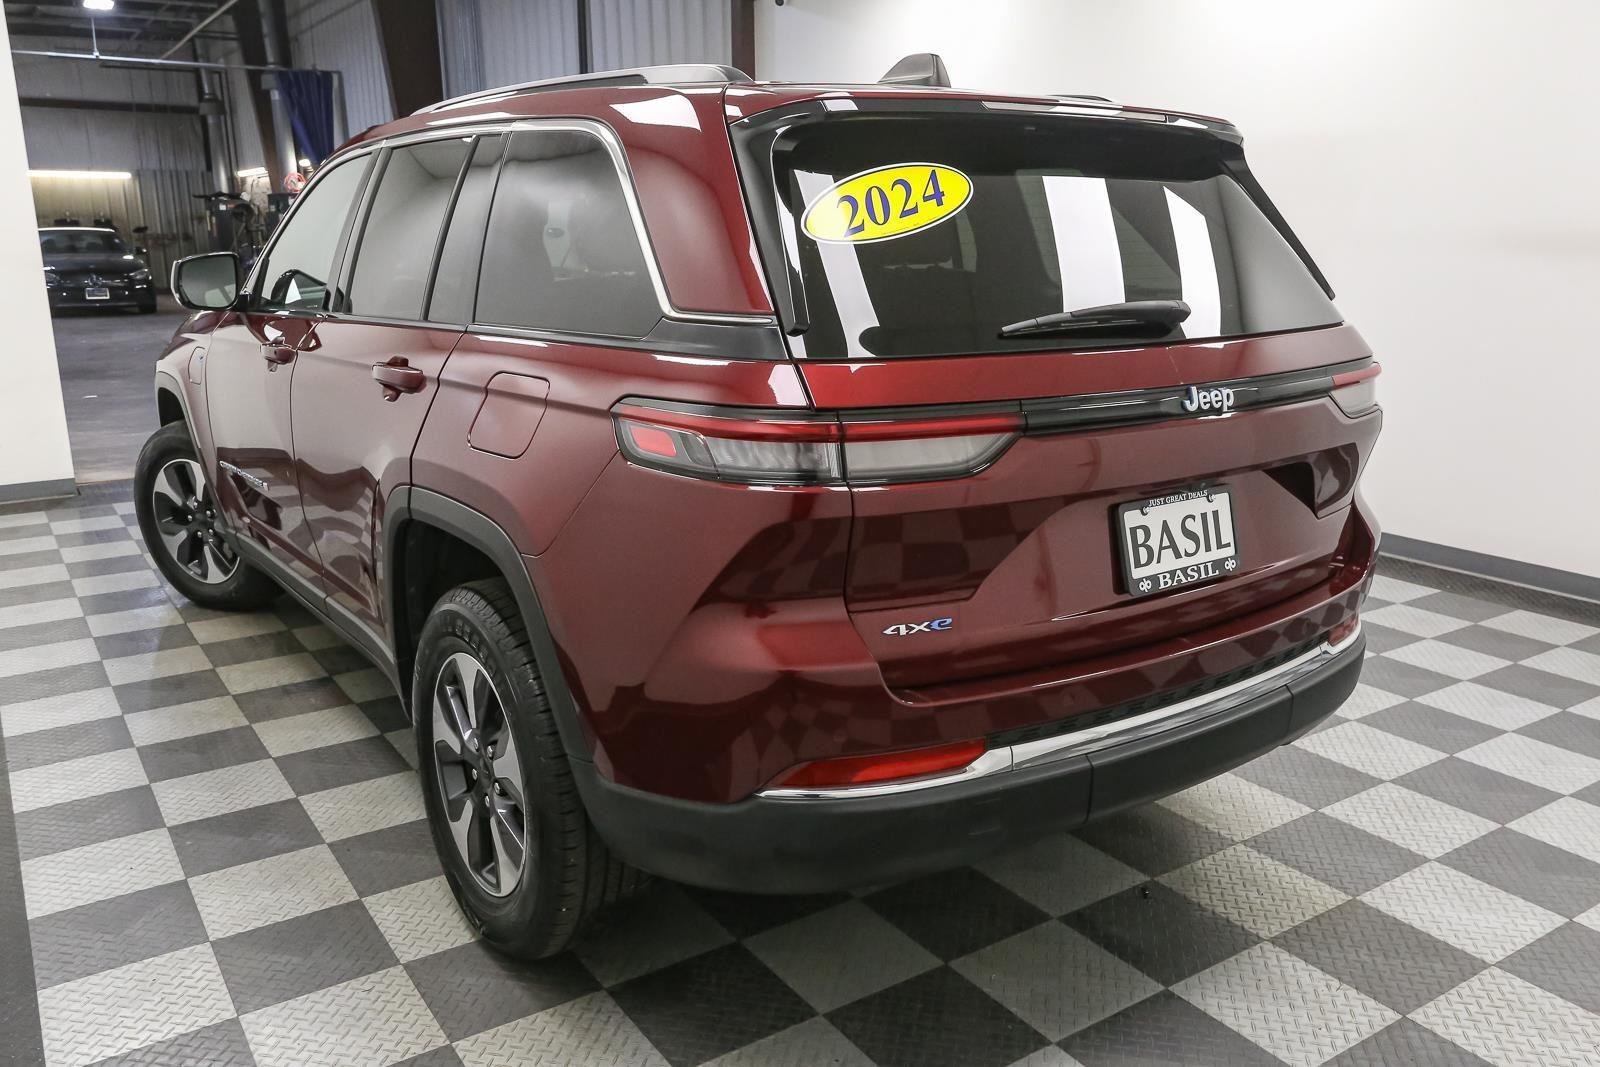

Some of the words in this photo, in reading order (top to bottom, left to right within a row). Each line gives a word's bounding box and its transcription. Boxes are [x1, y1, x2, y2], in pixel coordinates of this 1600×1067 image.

[837, 169, 945, 238] 2024
[1184, 386, 1235, 412] Jeep
[1148, 497, 1165, 507] JUST
[1165, 493, 1187, 504] GREAT
[1188, 489, 1208, 500] DEALS
[1129, 509, 1231, 570] BASIL
[1157, 562, 1219, 590] BASIL
